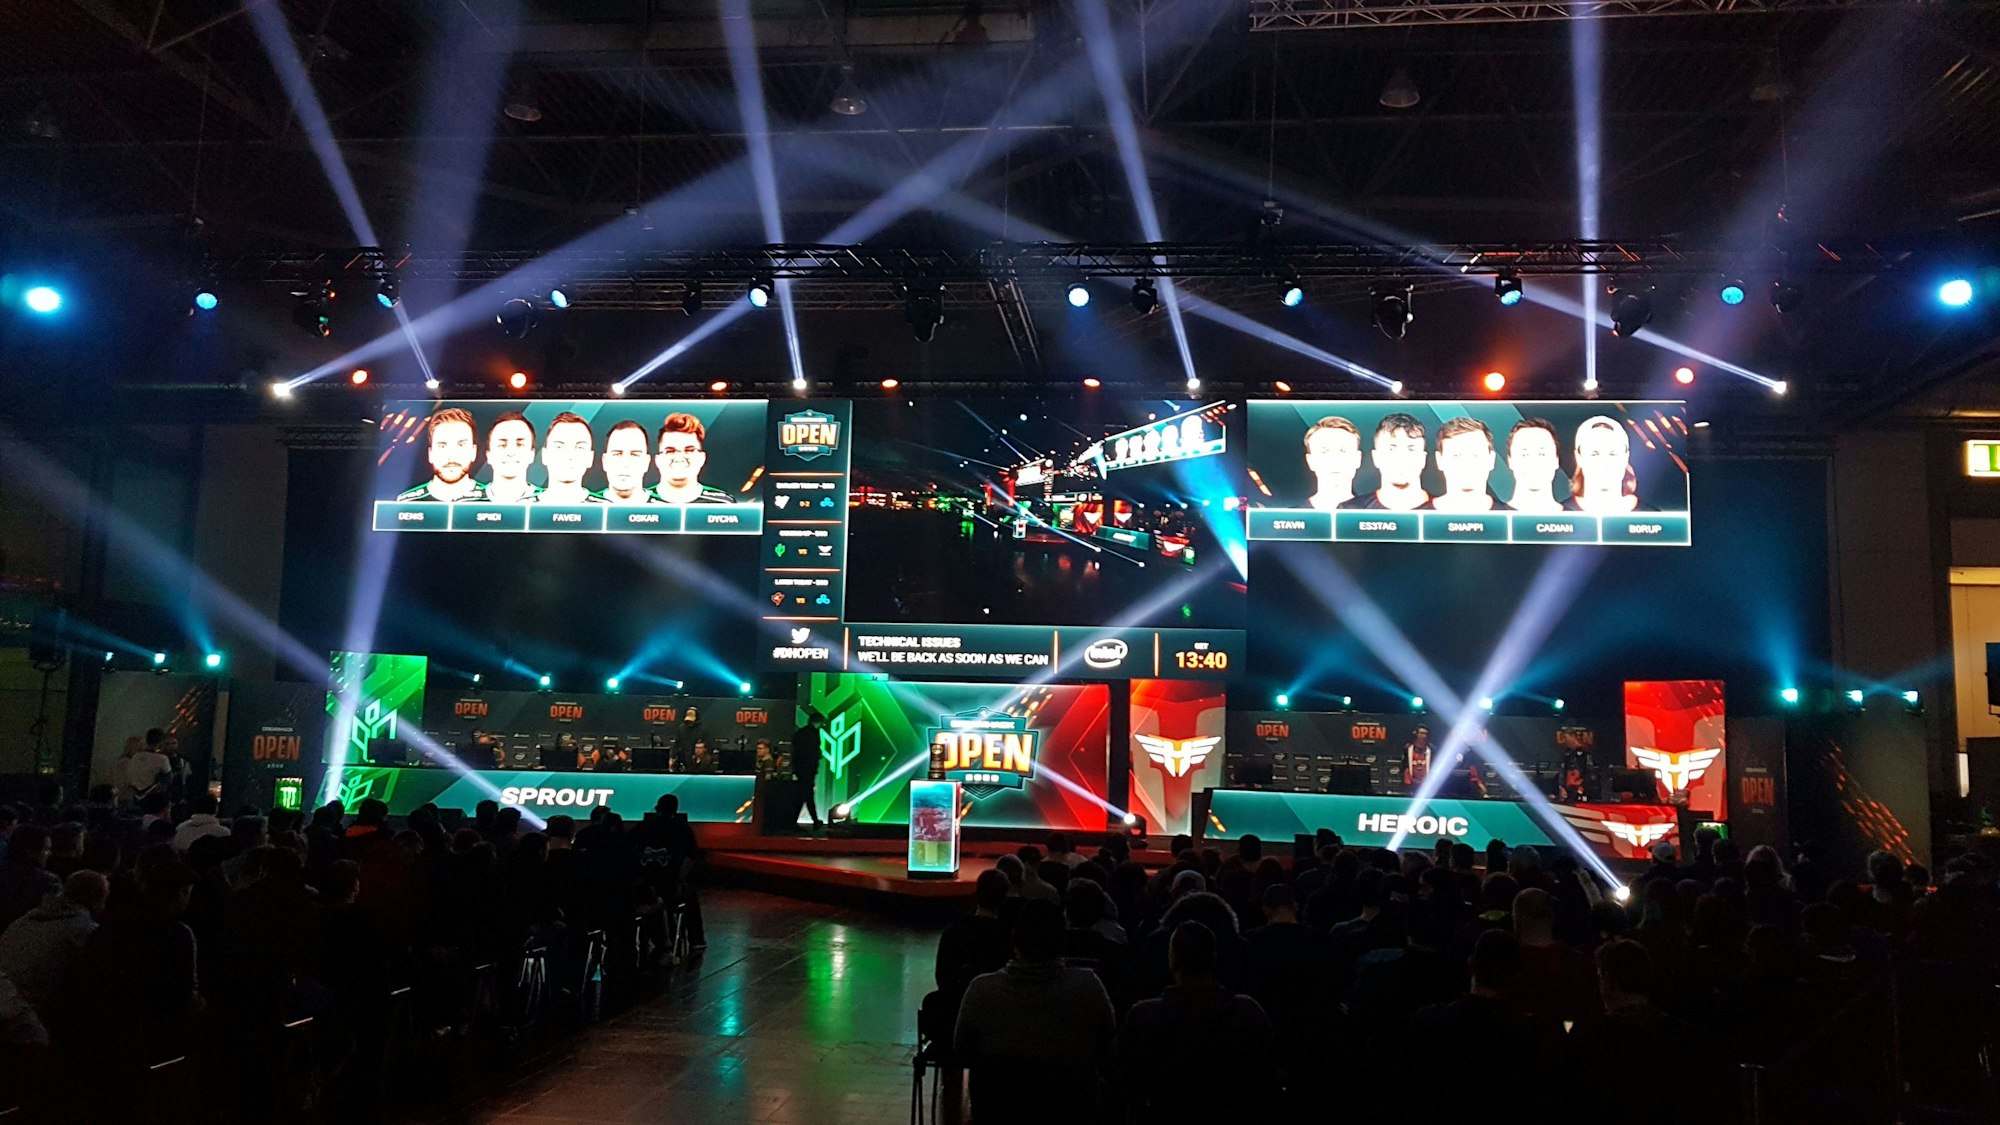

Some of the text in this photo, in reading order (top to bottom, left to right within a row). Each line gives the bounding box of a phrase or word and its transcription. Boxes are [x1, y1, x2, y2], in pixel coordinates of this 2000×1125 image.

[782, 423, 837, 445] OPEN
[398, 512, 424, 521] DENIS
[552, 513, 582, 522] FAVEN
[628, 514, 659, 523] OSKAR
[707, 514, 739, 523] DYCHA
[1273, 520, 1305, 529] STAVN
[1448, 523, 1484, 532] SNAPPI
[1536, 523, 1574, 533] CADIAN
[857, 635, 962, 648] TECHNICAL ISSUES
[772, 647, 829, 659] #DHOPEN
[891, 651, 906, 663] BE
[907, 652, 938, 663] BACK
[938, 652, 954, 664] AS
[955, 652, 987, 664] SOON
[987, 653, 1004, 665] AS
[1004, 653, 1023, 665] WE
[1024, 654, 1049, 666] CAN
[1175, 651, 1228, 669] 13:40
[455, 702, 488, 716] OPEN
[549, 705, 583, 719] OPEN
[643, 708, 676, 721] OPEN
[735, 711, 768, 724] OPEN
[1256, 724, 1290, 738] OPEN
[1351, 726, 1387, 740] OPEN
[253, 735, 302, 760] OPEN
[934, 732, 1033, 773] OPEN
[500, 786, 615, 807] SPROUT
[1741, 777, 1774, 805] OPEN
[1358, 812, 1469, 836] HEROIC
